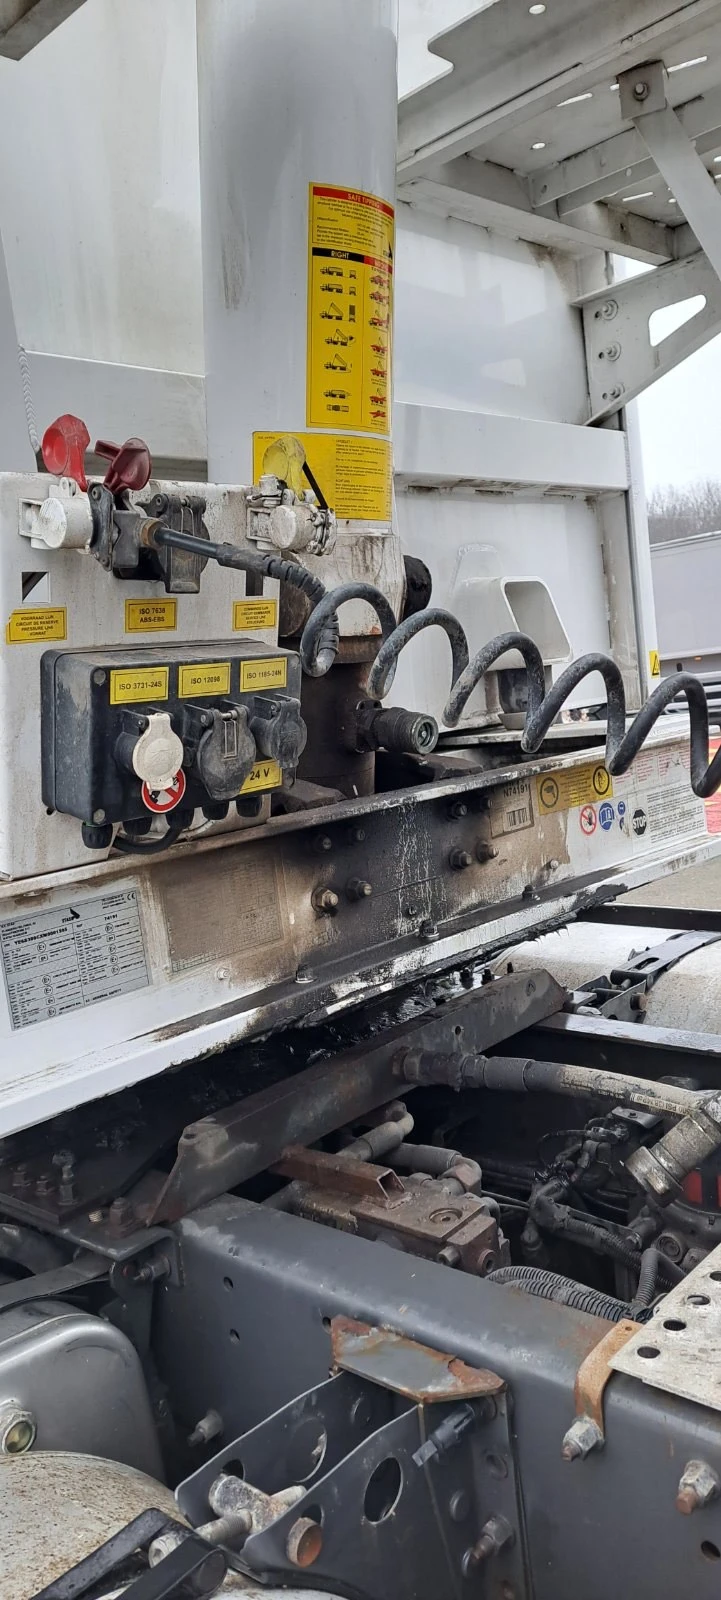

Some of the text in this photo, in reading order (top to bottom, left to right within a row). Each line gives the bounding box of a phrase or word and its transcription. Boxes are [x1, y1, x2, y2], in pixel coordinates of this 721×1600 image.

[348, 193, 380, 209] SAFE TIPPING
[331, 250, 349, 259] RIGHT
[250, 768, 270, 781] 24 V
[503, 784, 528, 798] N74191
[632, 815, 647, 830] STOP
